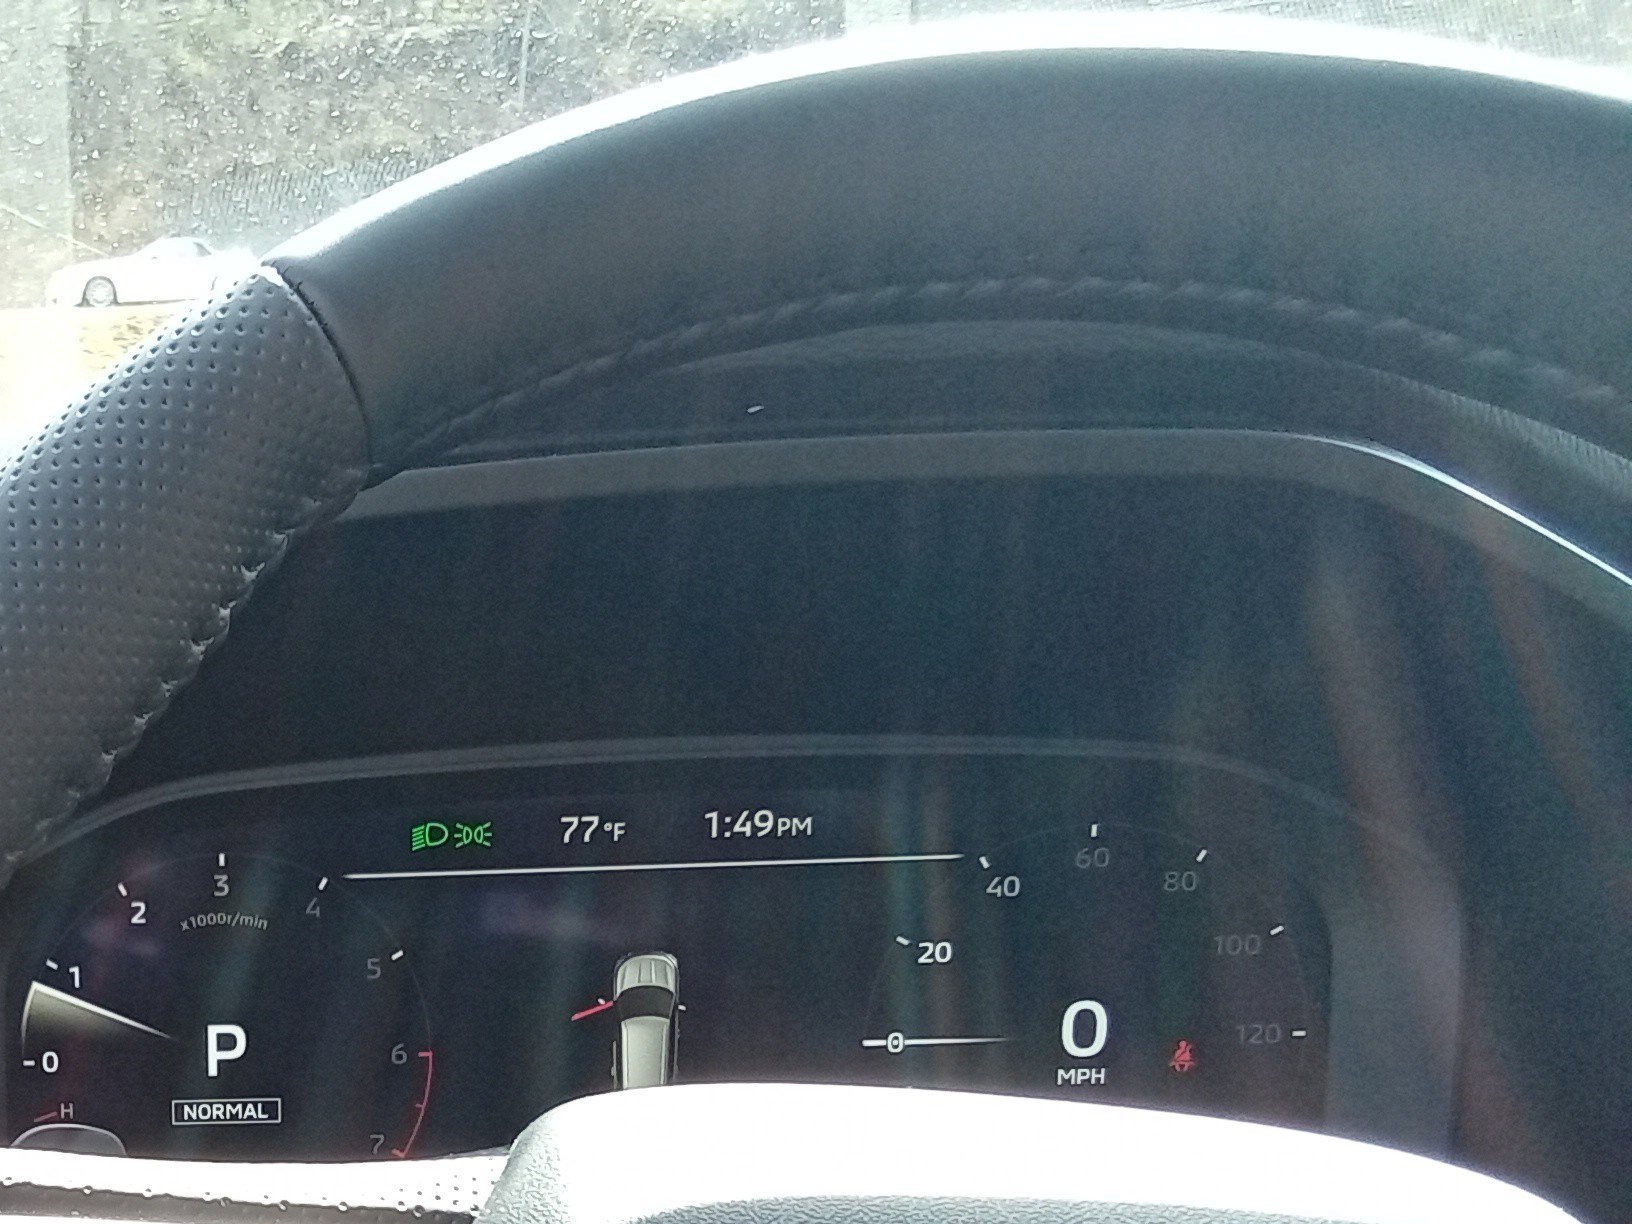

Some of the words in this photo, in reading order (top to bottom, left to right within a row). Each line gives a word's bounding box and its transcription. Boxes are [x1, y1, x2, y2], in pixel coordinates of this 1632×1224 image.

[1075, 847, 1110, 869] 60
[213, 874, 229, 897] 3
[985, 875, 1021, 897] 40
[1164, 871, 1197, 892] 80
[130, 901, 147, 924] 2
[305, 899, 321, 918] 4
[917, 941, 952, 964] 20
[1214, 934, 1261, 955] 100
[68, 966, 81, 988] 1
[367, 958, 382, 980] 5
[1060, 1000, 1108, 1058] 0
[1236, 1024, 1281, 1044] 120
[206, 1024, 248, 1077] P
[887, 1033, 904, 1053] 0
[42, 1052, 59, 1073] 0
[391, 1045, 408, 1065] 6
[1056, 1068, 1106, 1086] MPH
[60, 1104, 74, 1120] H
[182, 1102, 269, 1122] NORMAL
[369, 1135, 385, 1154] 7
